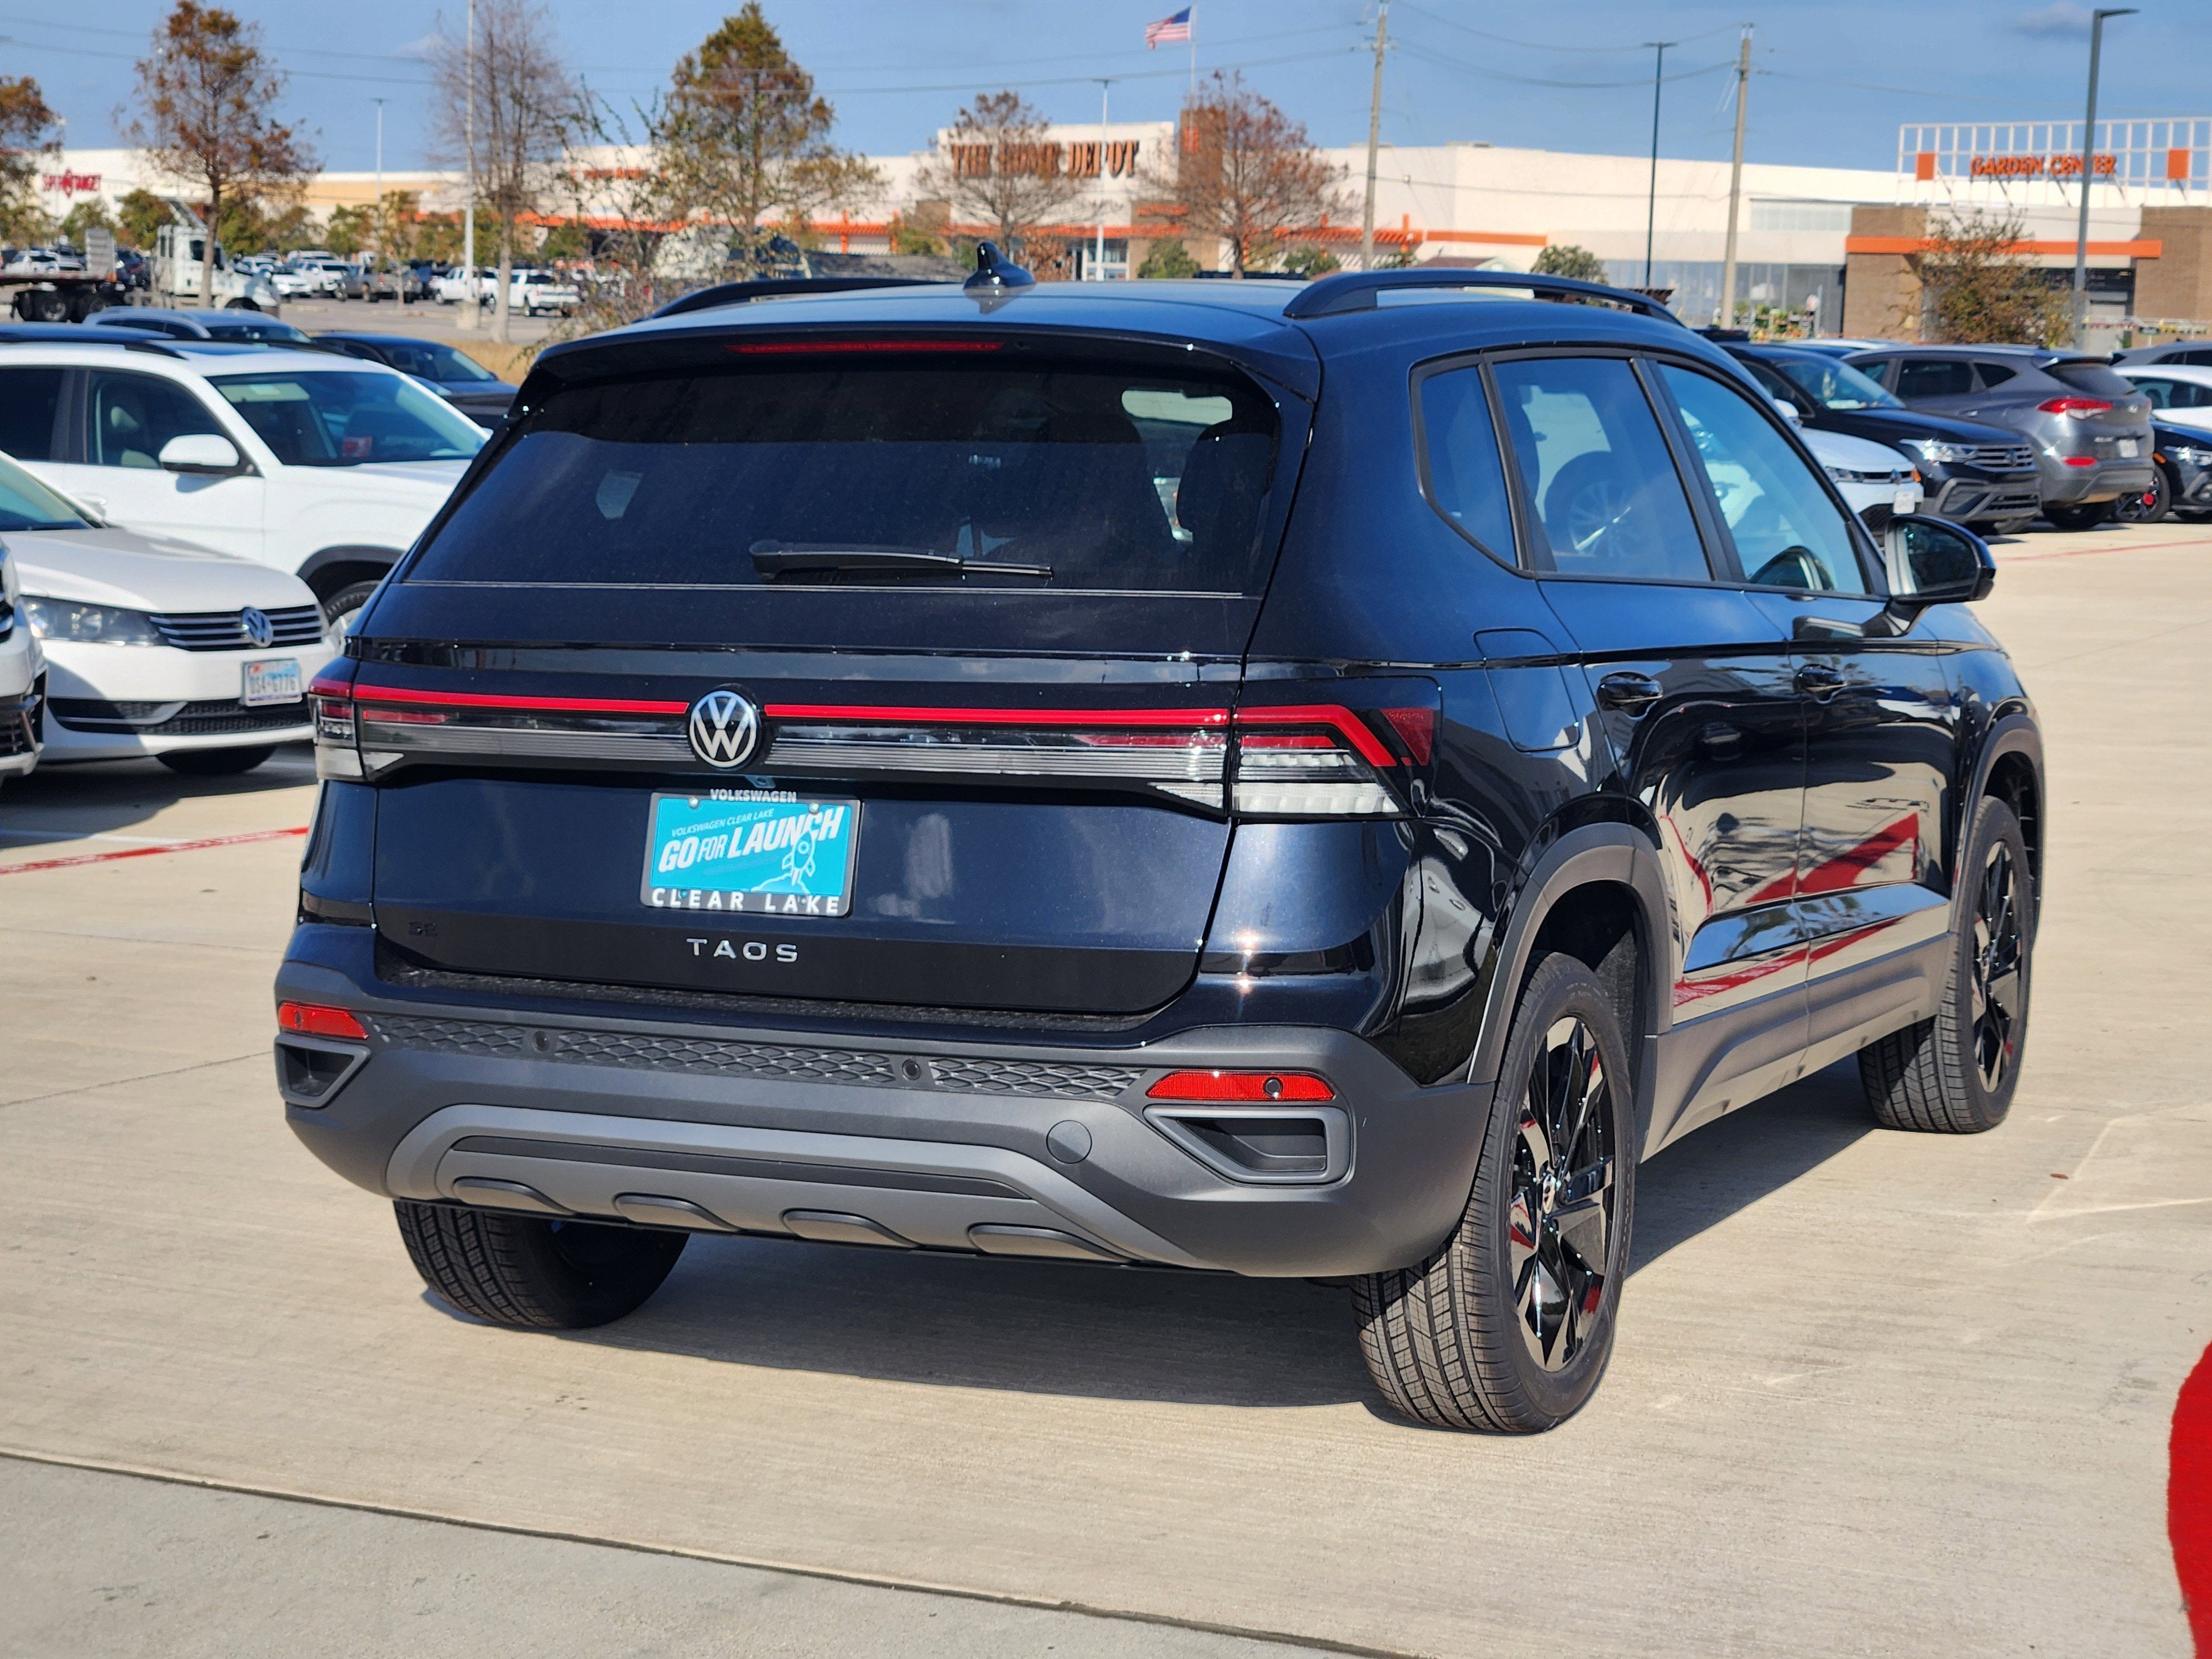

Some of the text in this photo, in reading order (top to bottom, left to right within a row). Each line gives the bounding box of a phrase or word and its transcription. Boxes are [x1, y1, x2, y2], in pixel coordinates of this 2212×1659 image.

[1970, 154, 2116, 175] GARDEN CENER
[710, 789, 797, 804] VOLKSWAGEN
[672, 808, 775, 837] VOLKSWAGEN CLEAR LAKE
[658, 806, 845, 873] GO FOR LAUNCH
[651, 888, 840, 915] CLEAR LAKE
[686, 938, 799, 963] TAOS
